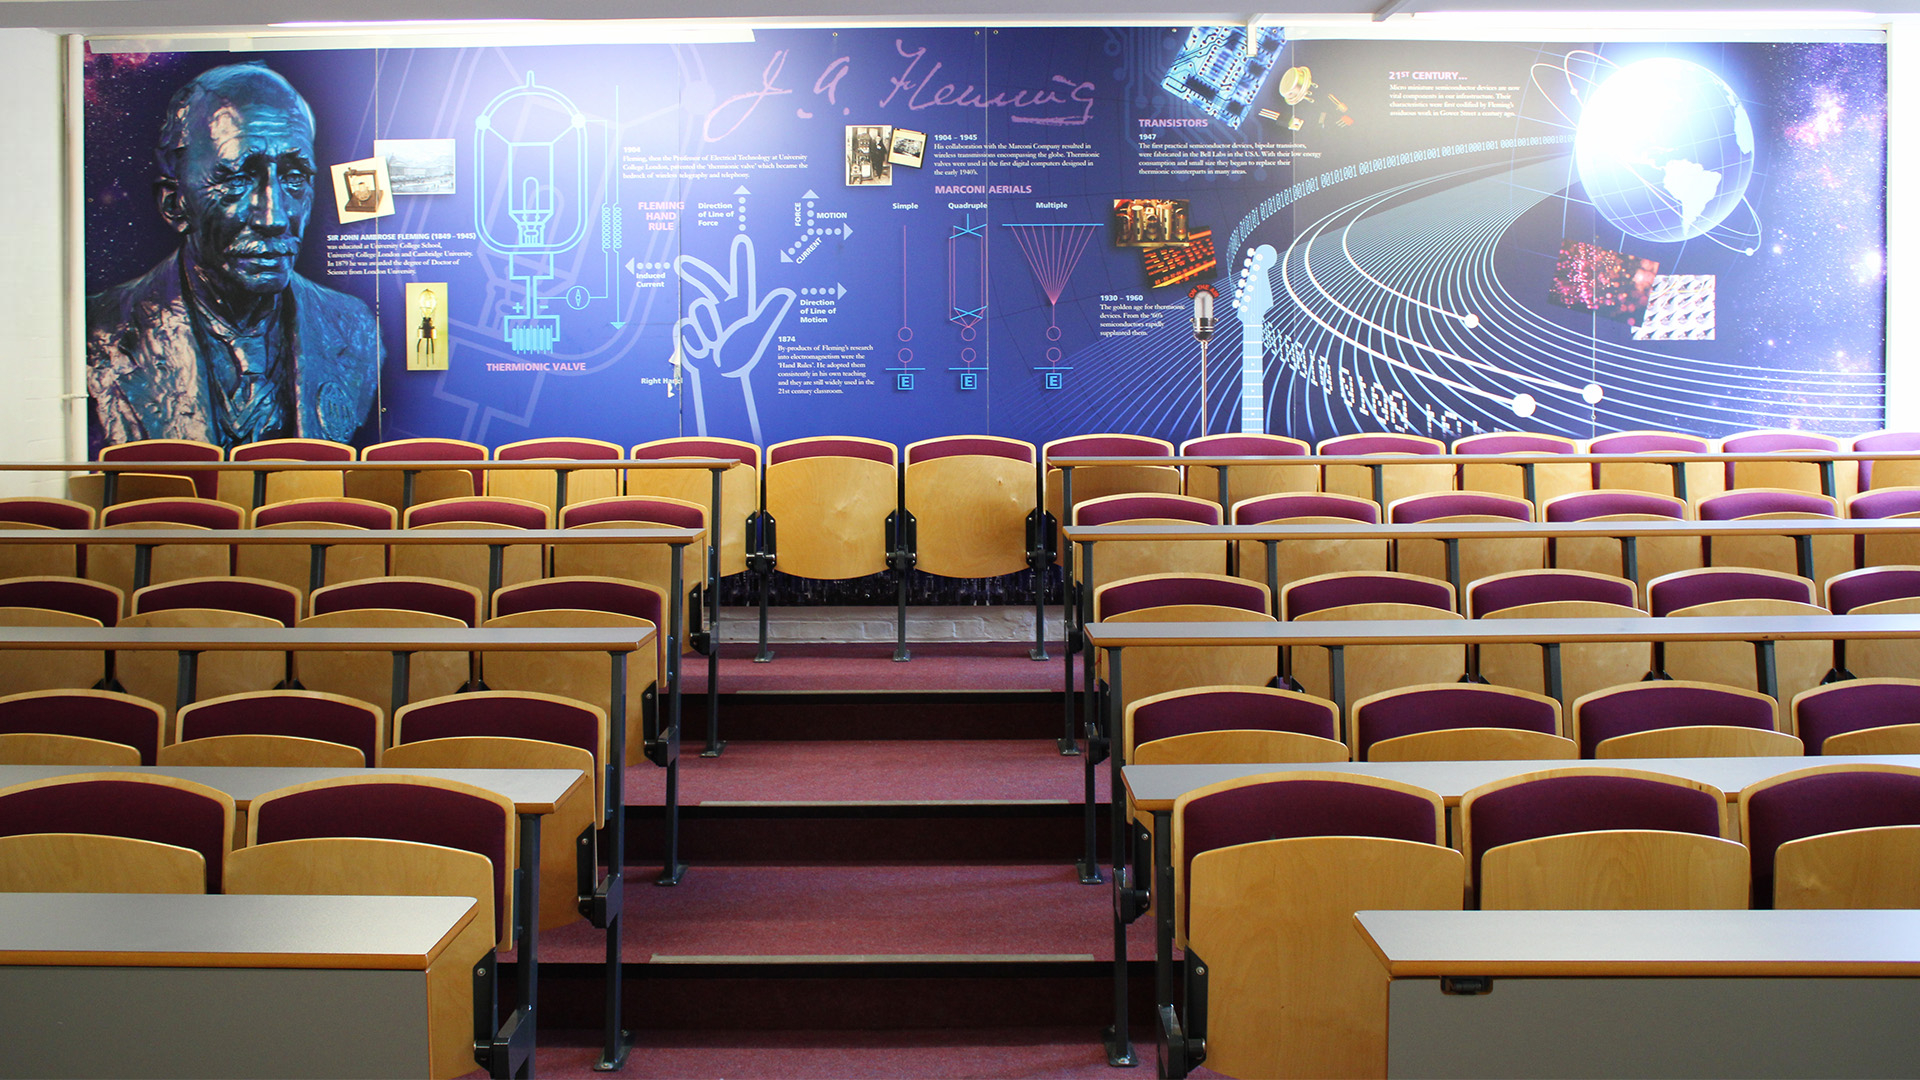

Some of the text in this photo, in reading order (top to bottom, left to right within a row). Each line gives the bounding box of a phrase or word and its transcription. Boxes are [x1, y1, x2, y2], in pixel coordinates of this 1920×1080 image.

[1138, 119, 1208, 127] TRANSISTORS
[638, 202, 684, 210] FLEMING
[646, 212, 676, 220] HAND
[796, 237, 822, 264] CURRENT
[486, 363, 586, 372] THERMIONIC VALVE
